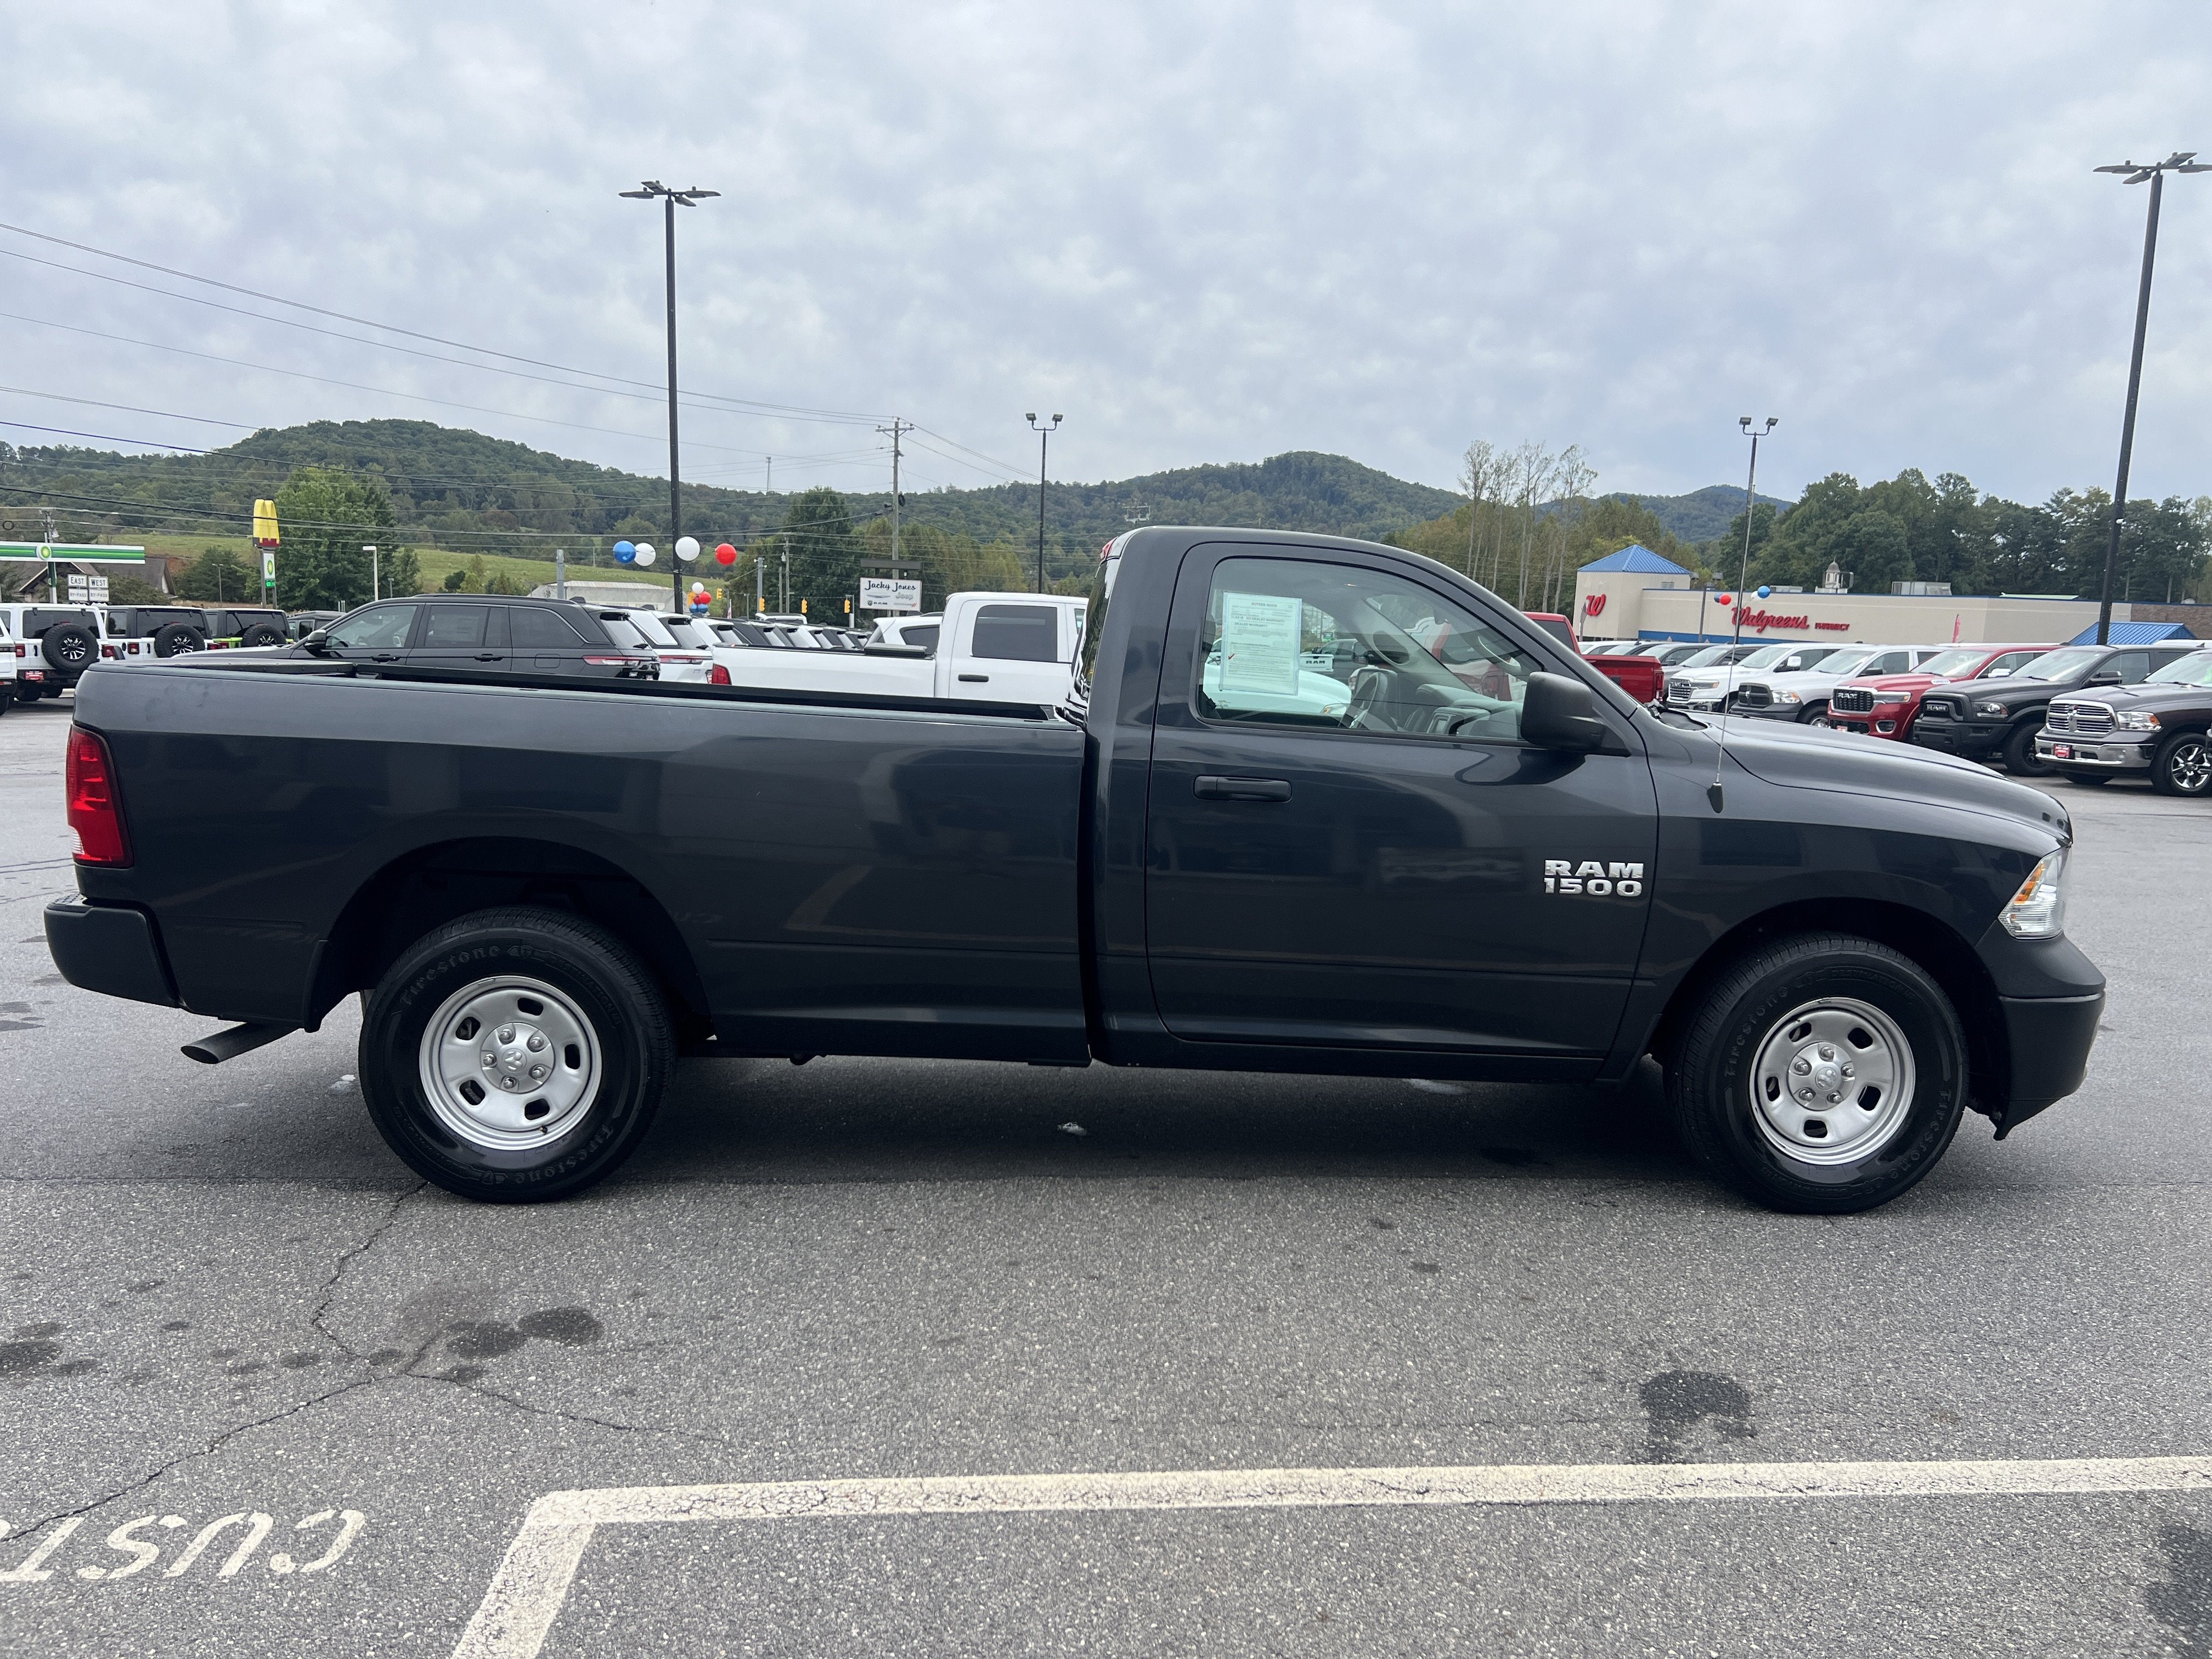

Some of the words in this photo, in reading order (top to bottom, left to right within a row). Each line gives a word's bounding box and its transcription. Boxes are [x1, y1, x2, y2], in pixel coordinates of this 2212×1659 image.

[70, 577, 84, 585] EAST
[865, 580, 891, 590] Jacky
[892, 582, 916, 592] Jones
[895, 592, 913, 600] Jeep
[1731, 606, 1809, 633] Walgreens
[1544, 859, 1644, 878] RAM
[1544, 878, 1642, 896] 1500
[399, 945, 501, 1006] Firestone
[1723, 986, 1789, 1078] Firestone
[1887, 1090, 1953, 1180] Firestone
[513, 1124, 614, 1184] Firestone
[0, 1510, 365, 1582] CUST
